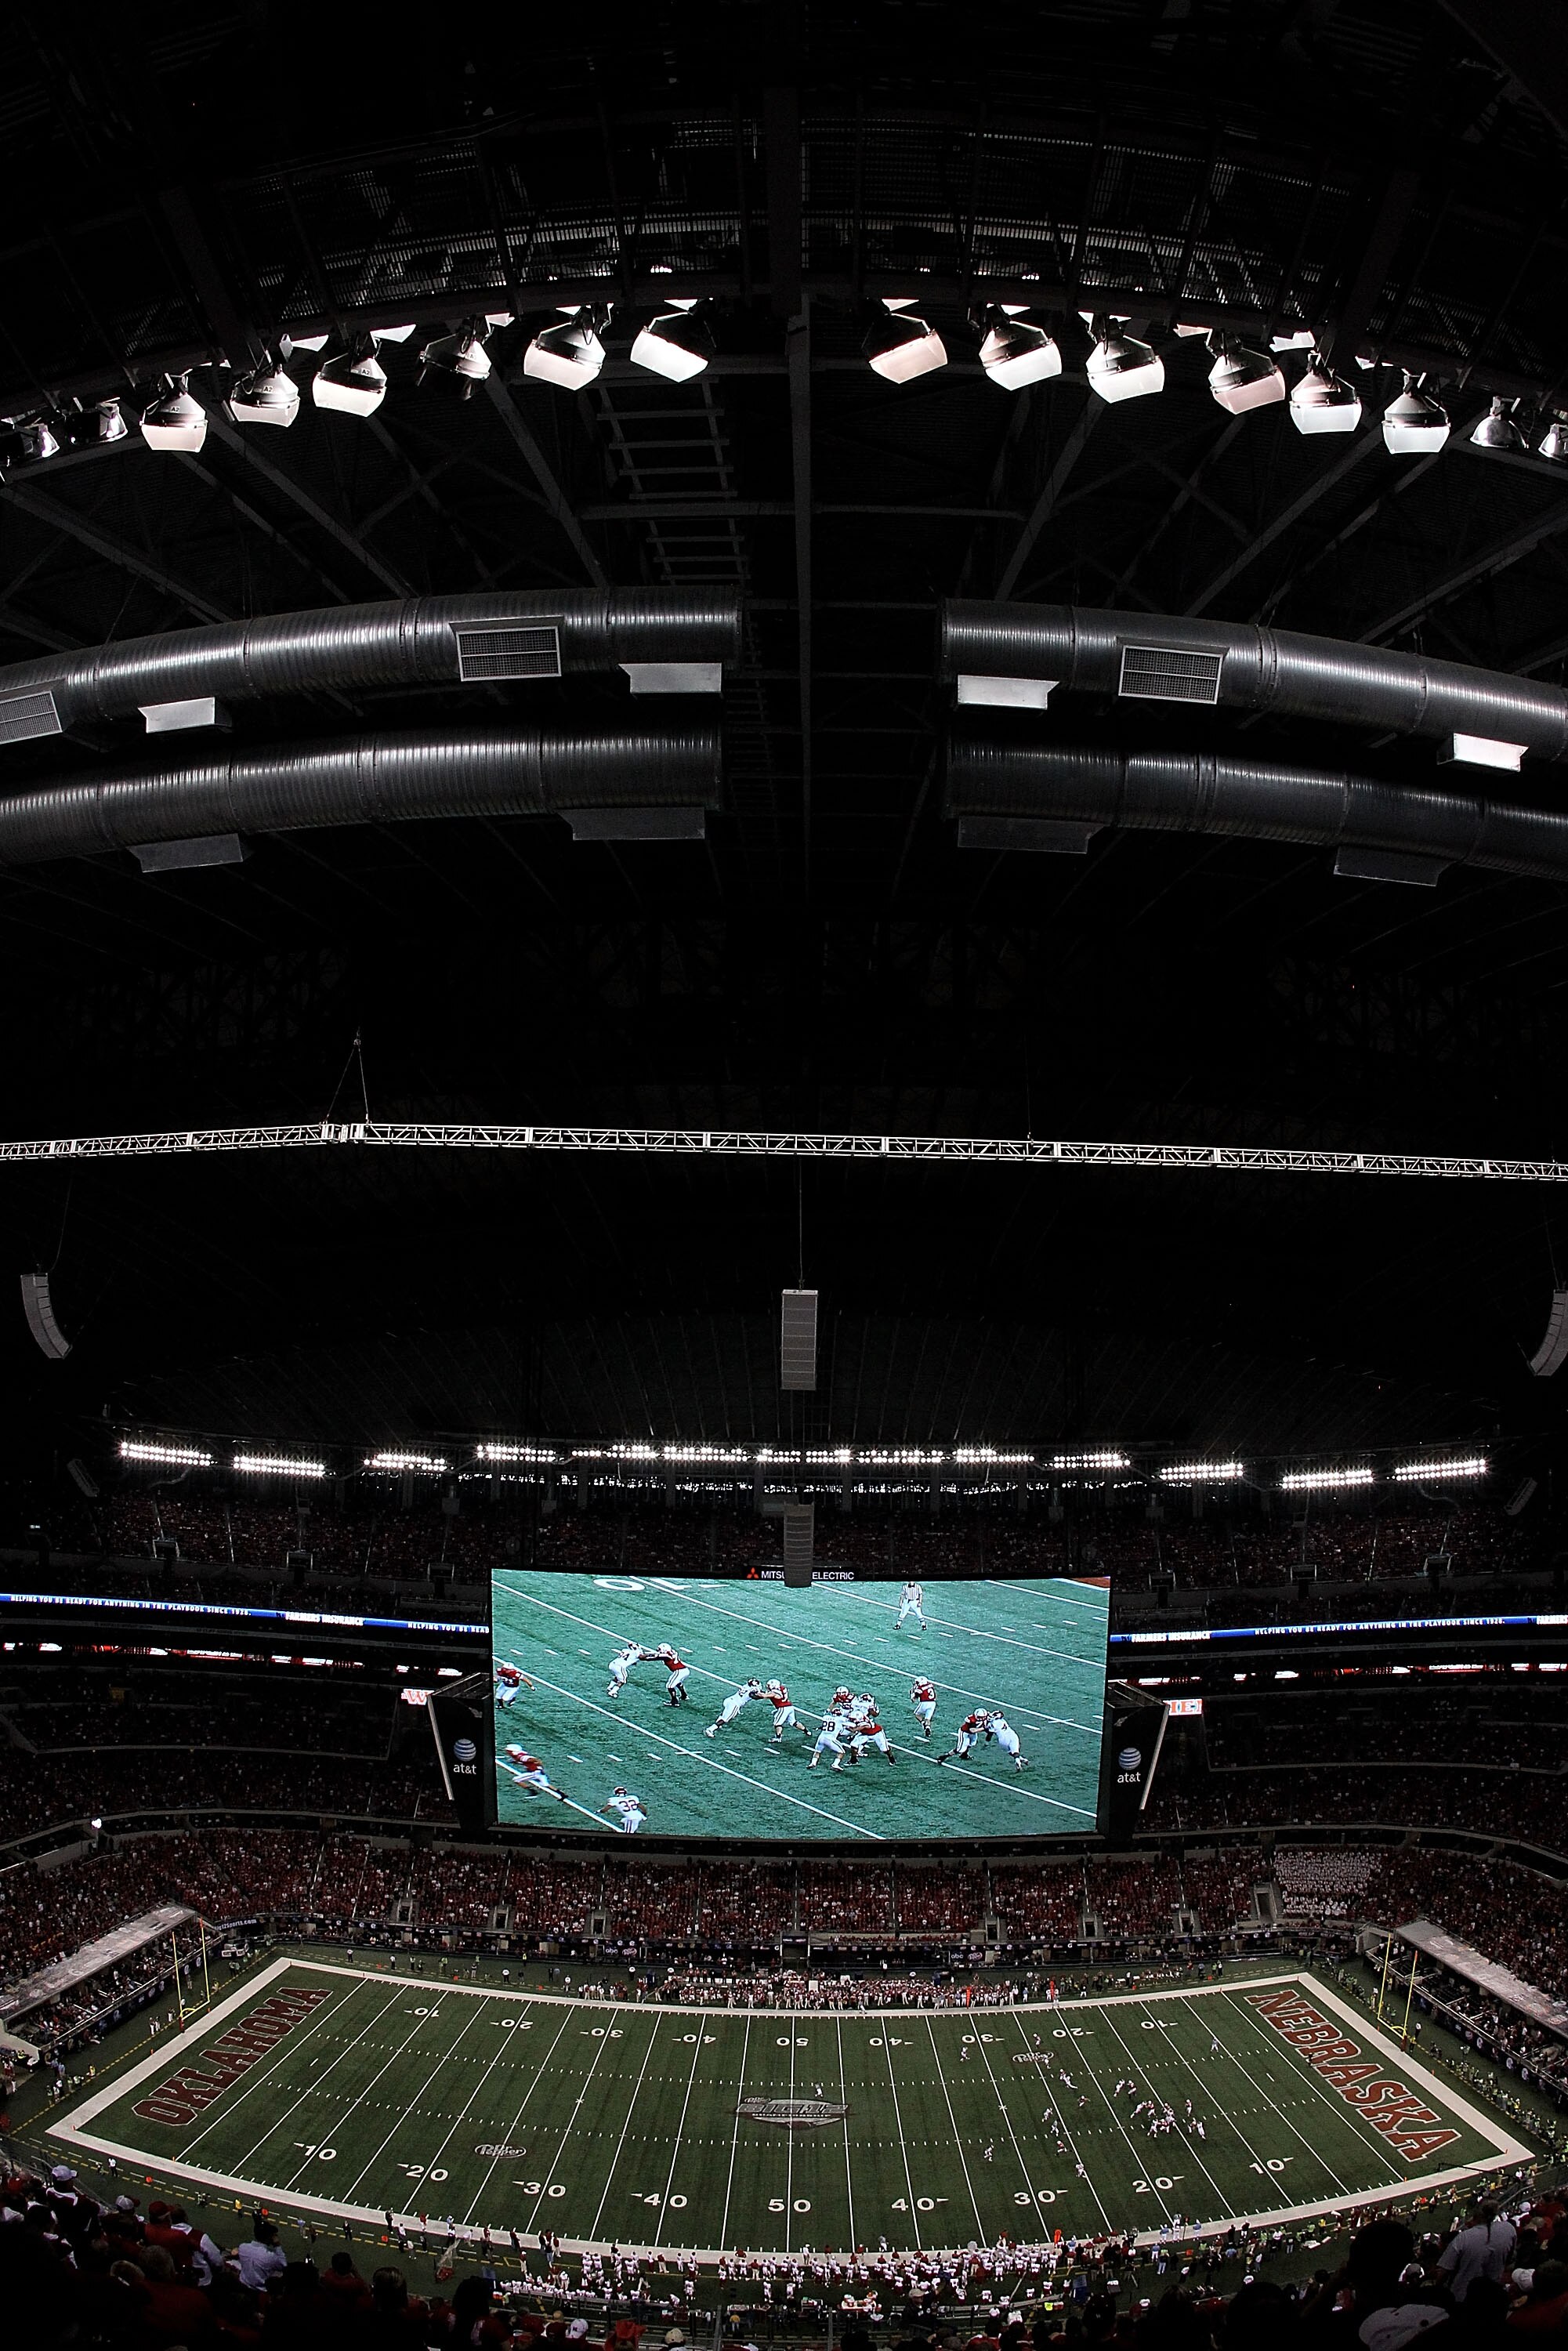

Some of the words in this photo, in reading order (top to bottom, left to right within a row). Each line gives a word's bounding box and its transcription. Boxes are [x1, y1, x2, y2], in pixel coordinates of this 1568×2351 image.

[761, 1570, 784, 1580] MITS
[812, 1571, 854, 1580] ELECTRIC
[104, 1599, 140, 1608] ANYTHING
[168, 1603, 205, 1612] PLAYBOOK
[285, 1611, 320, 1622] FARMERS
[321, 1614, 364, 1626] INSURANCE
[1359, 1621, 1396, 1630] ANYTHING
[1424, 1618, 1461, 1627] PLAYBOOK
[1132, 1633, 1168, 1643] FARMERS
[1168, 1631, 1211, 1641] INSURANCE
[822, 1721, 835, 1732] 28
[453, 1763, 477, 1775] at&t
[1117, 1771, 1141, 1783] at&t
[618, 1799, 639, 1812] 32
[132, 1987, 334, 2126] OKLAHOMA
[1244, 1989, 1462, 2163] NEBRASKA
[303, 2145, 337, 2161] 10
[406, 2164, 449, 2182] 20
[1248, 2158, 1285, 2175] 10
[523, 2181, 567, 2197] 30
[1132, 2177, 1174, 2193] 20
[643, 2192, 689, 2208] 40
[767, 2198, 812, 2212] 50
[891, 2197, 935, 2212] 40
[1013, 2190, 1056, 2205] 30
